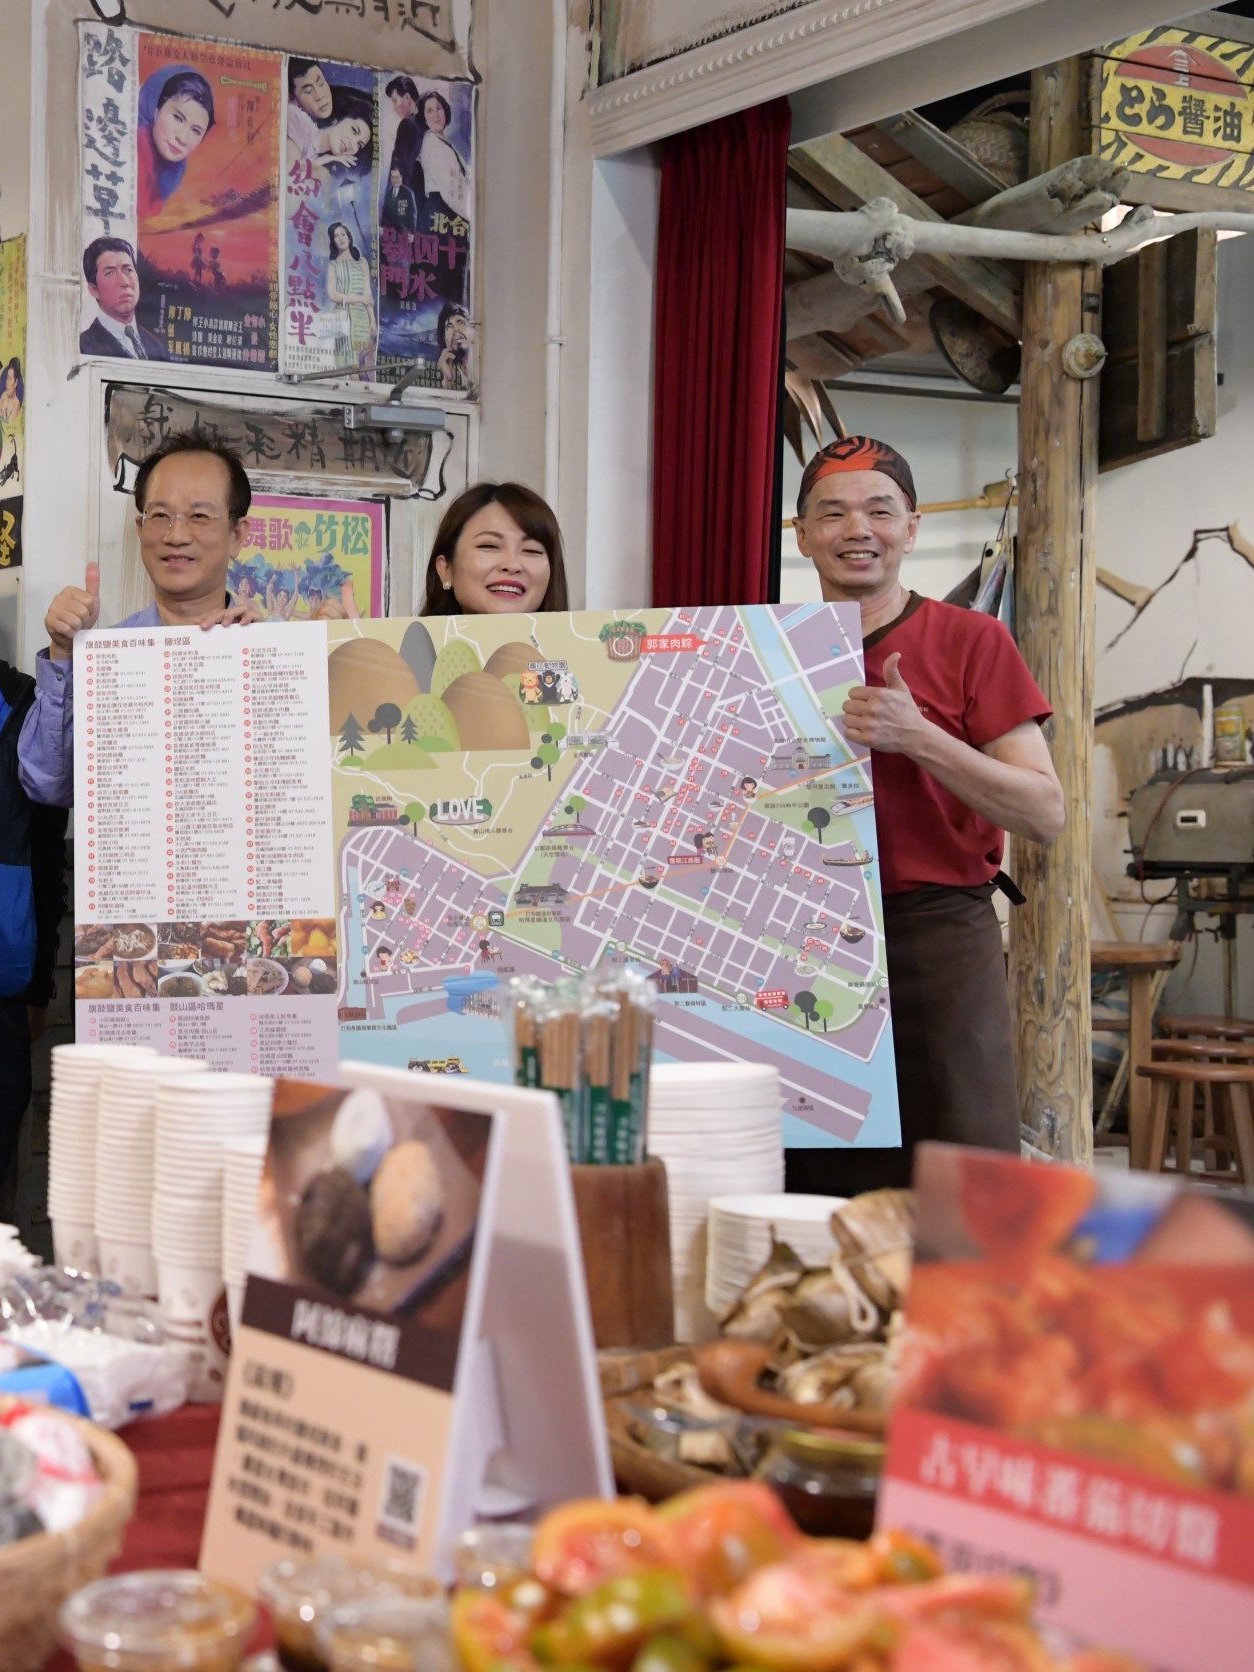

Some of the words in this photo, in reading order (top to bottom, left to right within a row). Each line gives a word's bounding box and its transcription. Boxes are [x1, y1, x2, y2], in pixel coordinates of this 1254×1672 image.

[646, 638, 693, 649] 郭家肉粽
[437, 798, 484, 821] LOVE
